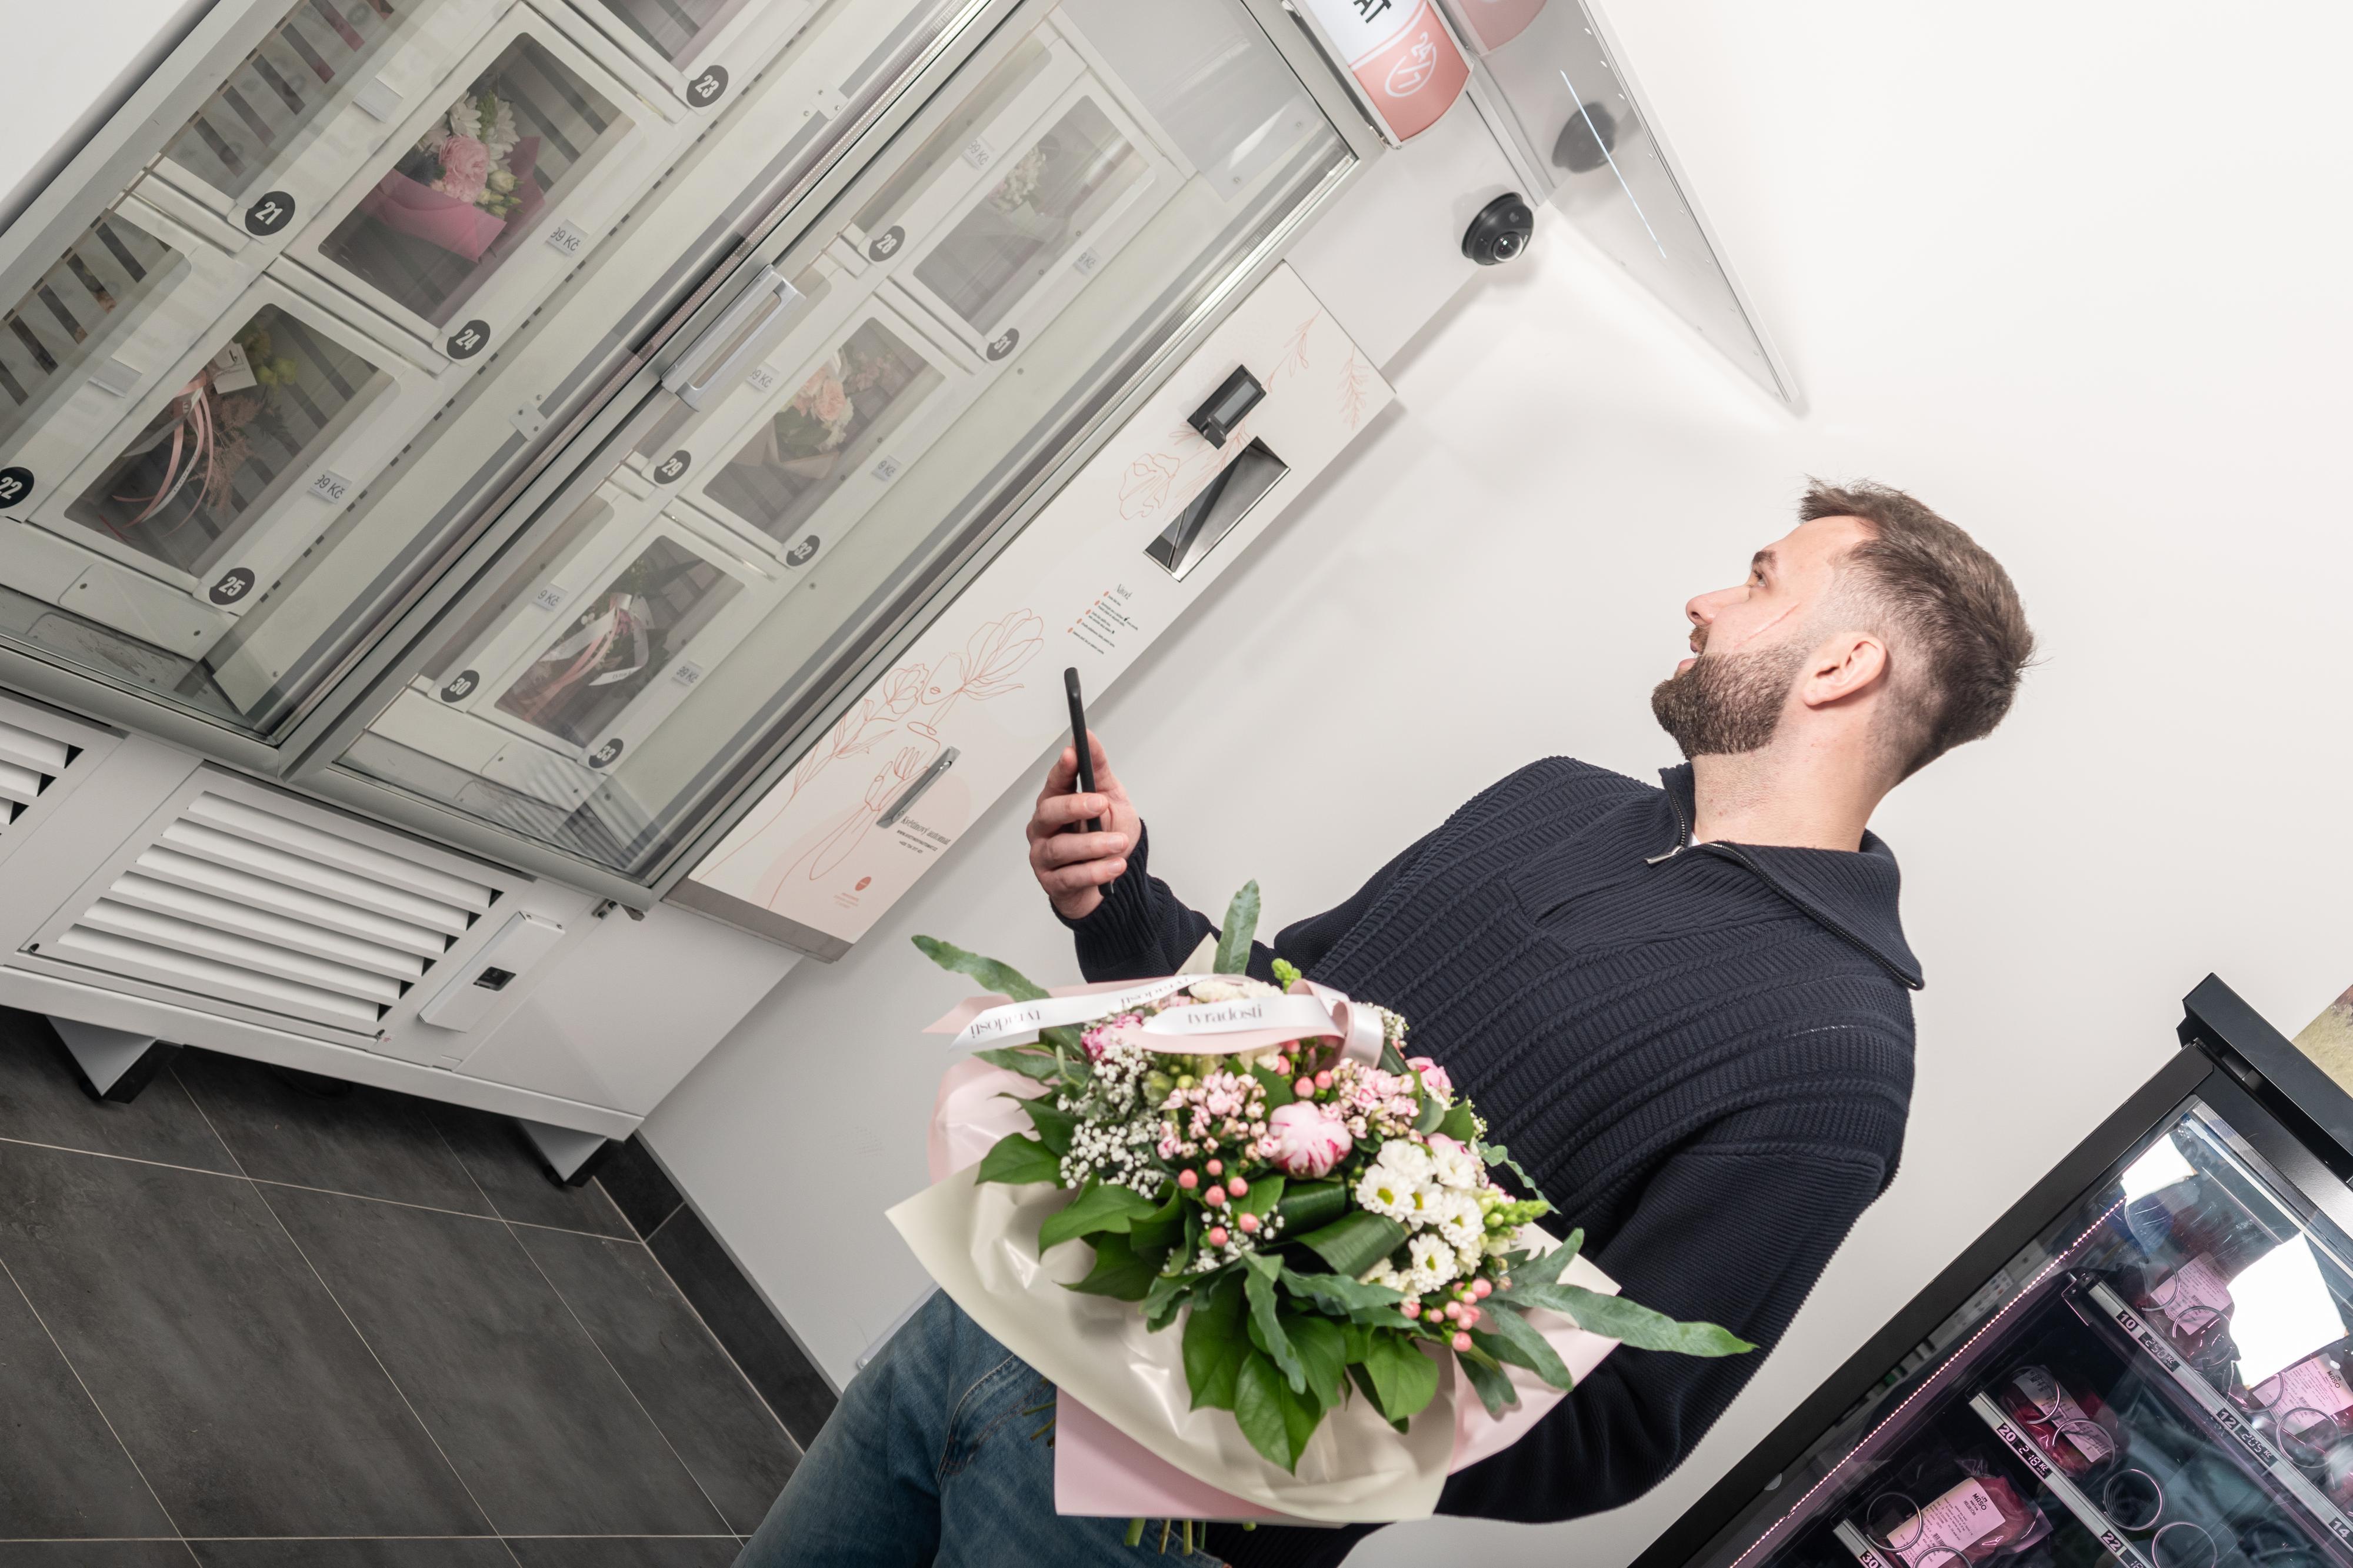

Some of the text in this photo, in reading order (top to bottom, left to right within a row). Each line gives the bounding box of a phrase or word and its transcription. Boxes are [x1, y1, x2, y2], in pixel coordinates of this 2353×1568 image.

[1398, 31, 1435, 89] 24/7
[695, 75, 719, 98] 23
[975, 151, 989, 165] Kč
[255, 201, 282, 225] 21
[564, 235, 581, 251] Kč
[876, 233, 898, 253] 28
[1083, 256, 1096, 269] Kč
[455, 329, 481, 351] 24
[994, 335, 1012, 353] 31
[758, 373, 774, 388] Kč
[662, 458, 683, 476] 29
[884, 465, 896, 477] Kč
[0, 477, 22, 499] 22
[326, 483, 345, 499] Kč
[794, 542, 812, 559] 32
[218, 576, 245, 596] 25
[545, 593, 560, 607] Kč
[449, 678, 471, 695] 30
[685, 672, 699, 684] Kč
[596, 745, 616, 762] 33
[926, 828, 951, 845] automat
[1188, 1003, 1263, 1025] tyradosti
[2119, 1313, 2137, 1329] 10
[2327, 1370, 2341, 1389] MASO
[2220, 1412, 2237, 1429] 12
[1998, 1425, 2017, 1442] 20
[2018, 1445, 2048, 1472] 218 Kč
[1972, 1493, 1987, 1510] MASO
[2333, 1521, 2351, 1538] 14
[2102, 1533, 2121, 1551] 22
[1862, 1553, 1879, 1568] 30
